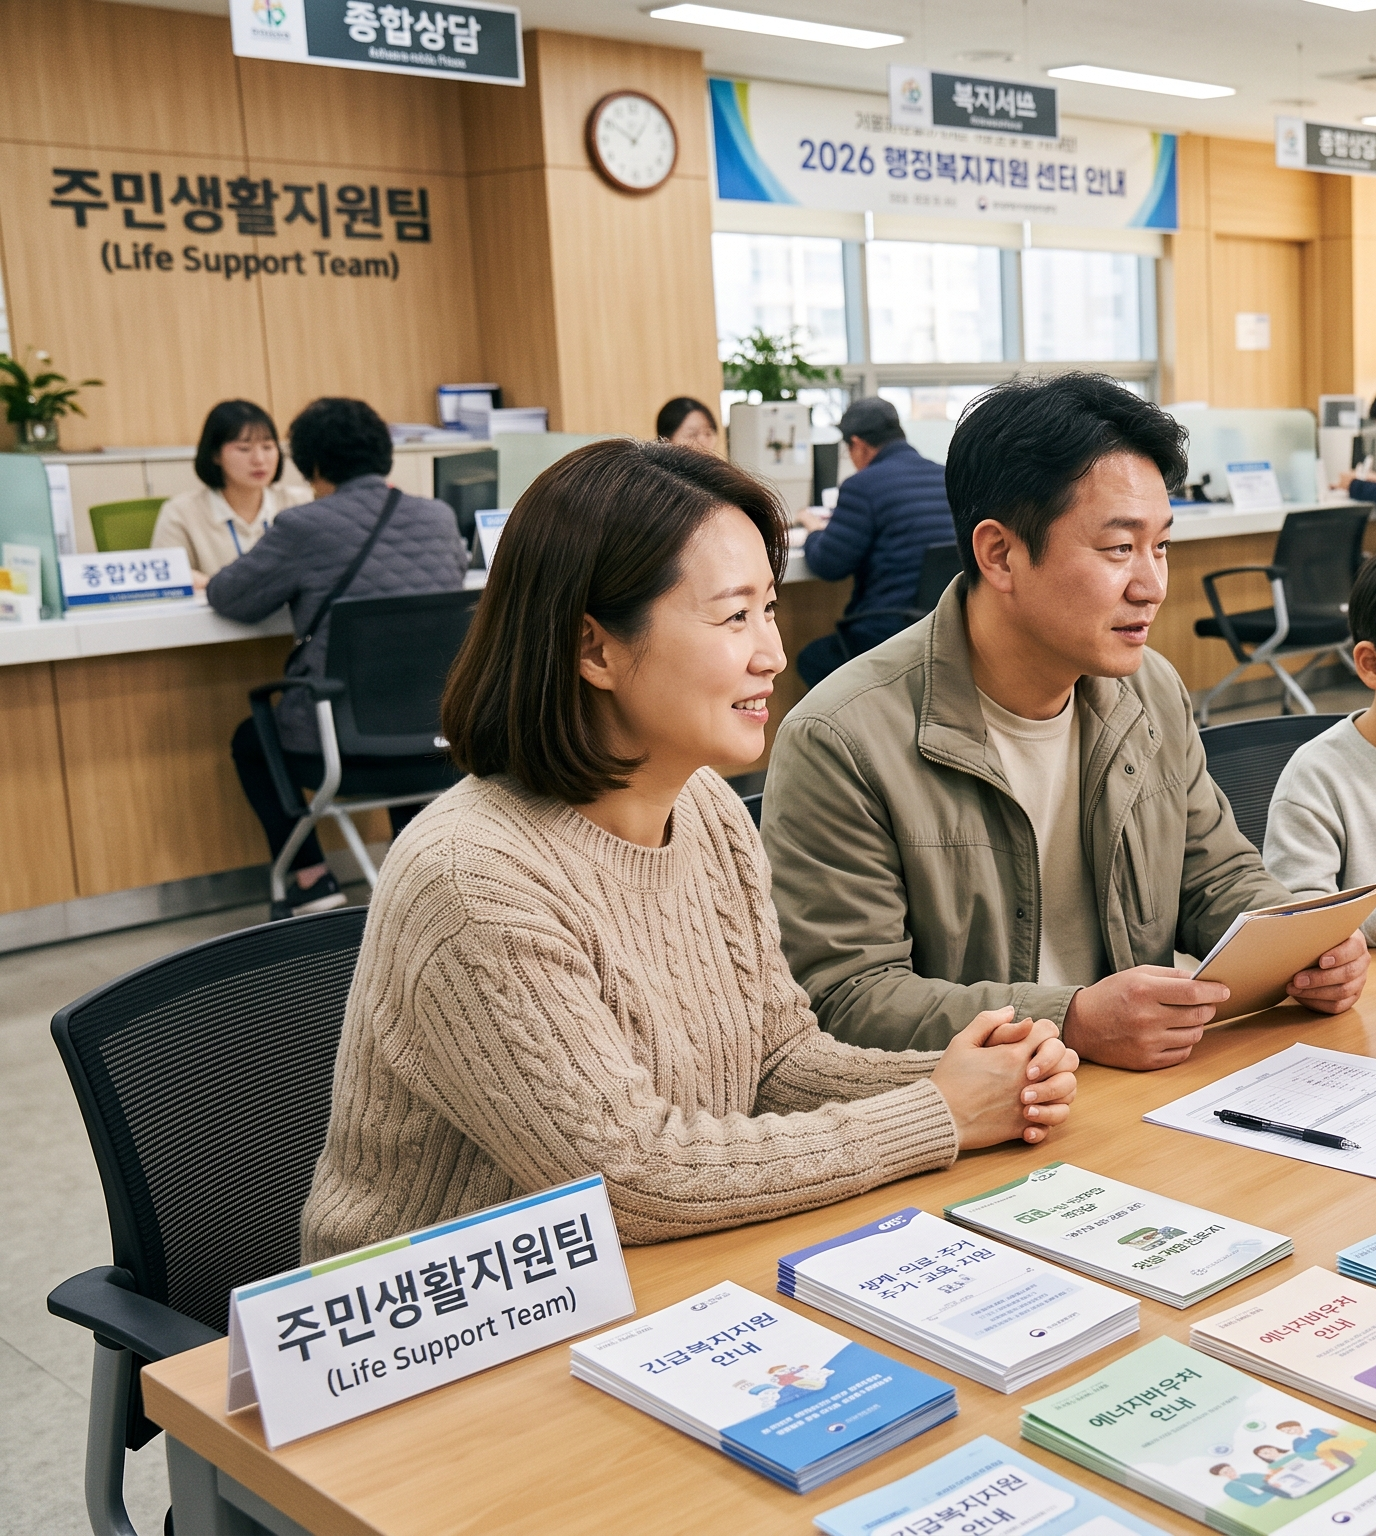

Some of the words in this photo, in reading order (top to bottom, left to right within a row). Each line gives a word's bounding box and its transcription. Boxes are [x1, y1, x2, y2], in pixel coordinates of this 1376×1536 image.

[344, 0, 481, 55] 종합상담
[799, 139, 875, 175] 2026
[884, 147, 1029, 189] 행정복지지원
[1035, 161, 1078, 193] 센터
[1085, 167, 1126, 197] 안내
[50, 167, 432, 244] 주민생활지원팀
[101, 241, 174, 274] (Life
[183, 246, 306, 280] Support
[312, 249, 401, 280] Team)
[84, 560, 170, 588] 종합상담
[276, 1213, 599, 1363] 주민생활지원팀
[326, 1357, 388, 1397] (Life
[394, 1315, 499, 1371] Support
[502, 1285, 578, 1331] Team)
[639, 1312, 778, 1374] 긴급복지지원
[711, 1341, 763, 1367] 안내
[1314, 1318, 1356, 1340] 안내
[1088, 1367, 1203, 1428] 에너지바우처
[1149, 1396, 1197, 1422] 안내
